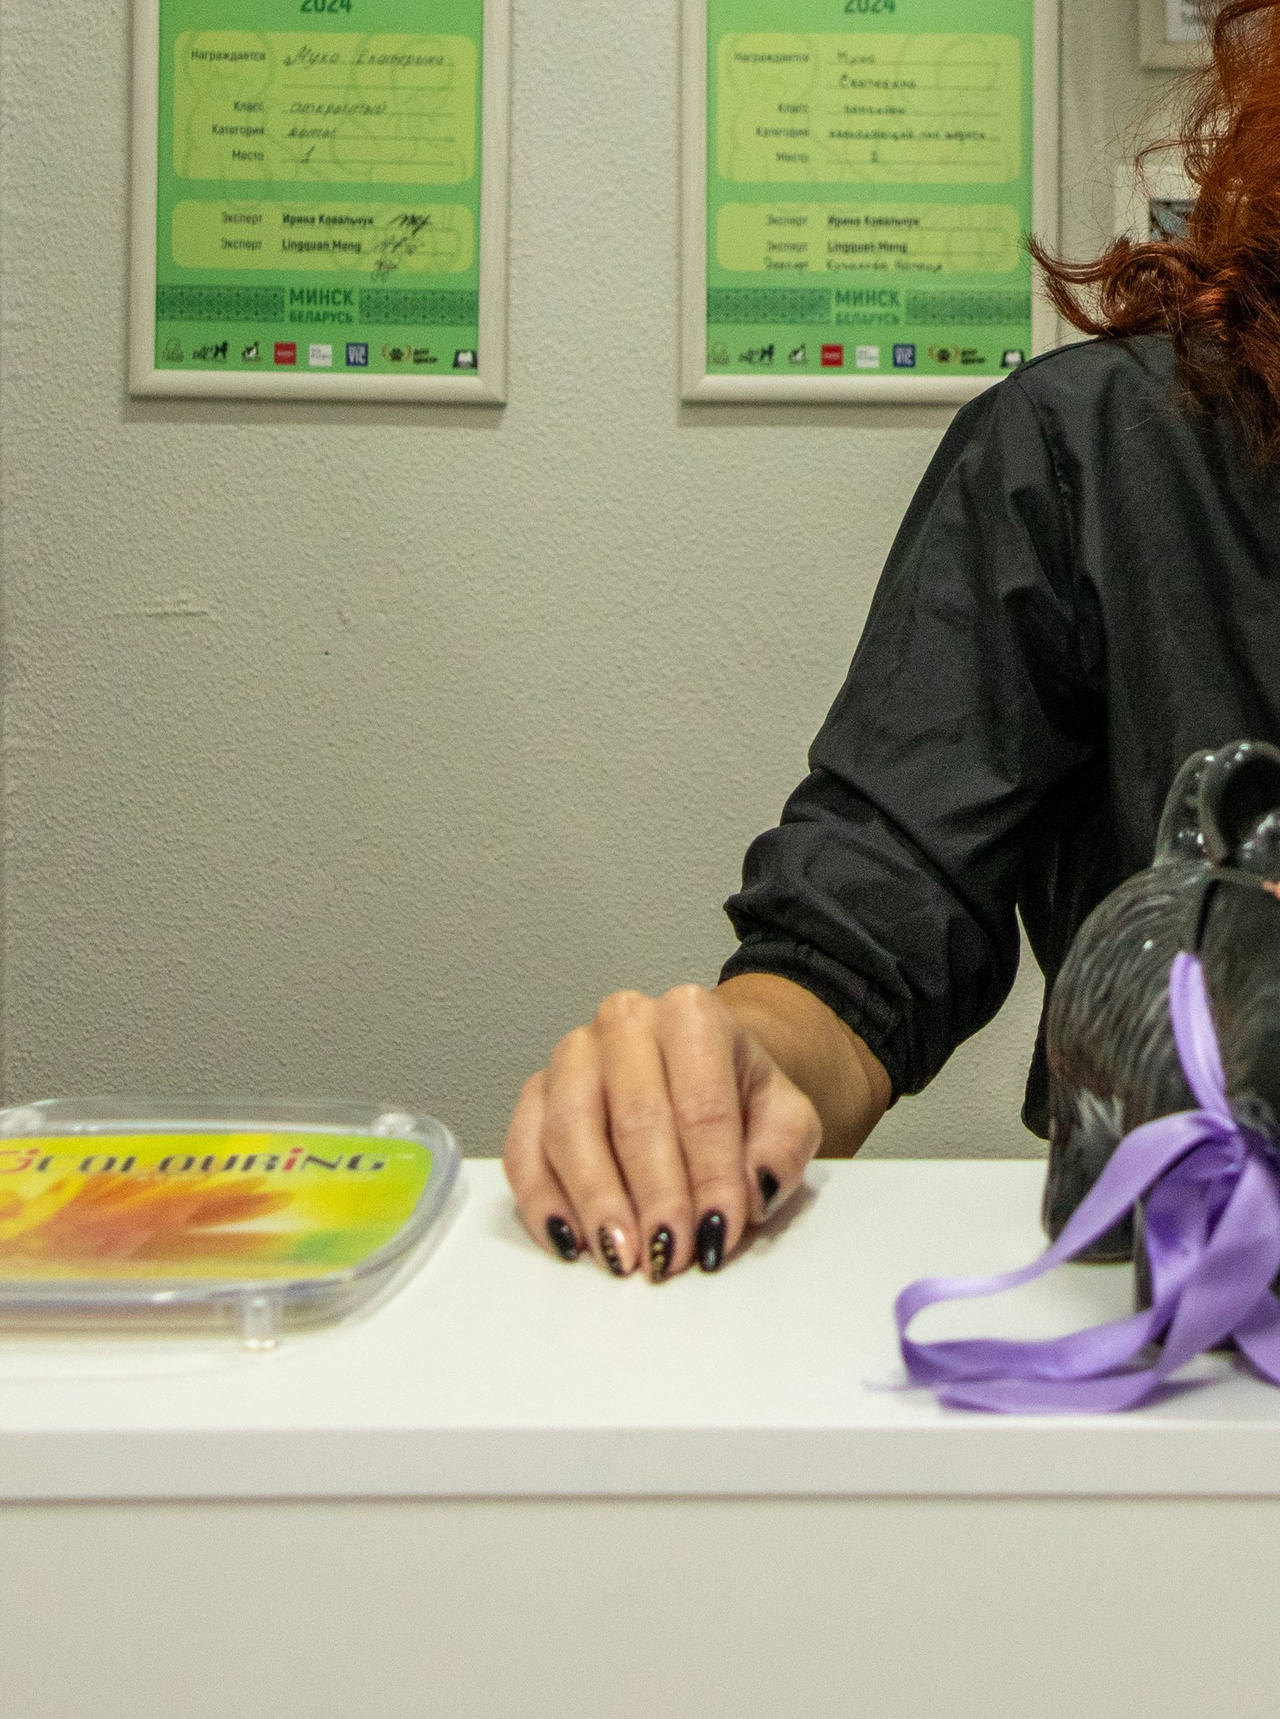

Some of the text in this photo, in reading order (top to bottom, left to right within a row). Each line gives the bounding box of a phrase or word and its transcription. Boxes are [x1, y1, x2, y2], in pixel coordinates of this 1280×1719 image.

[282, 214, 315, 226] Ирина
[289, 289, 354, 306] МИНСК
[834, 290, 899, 307] МИНСК
[289, 310, 354, 324] БЕЛАРУСЬ
